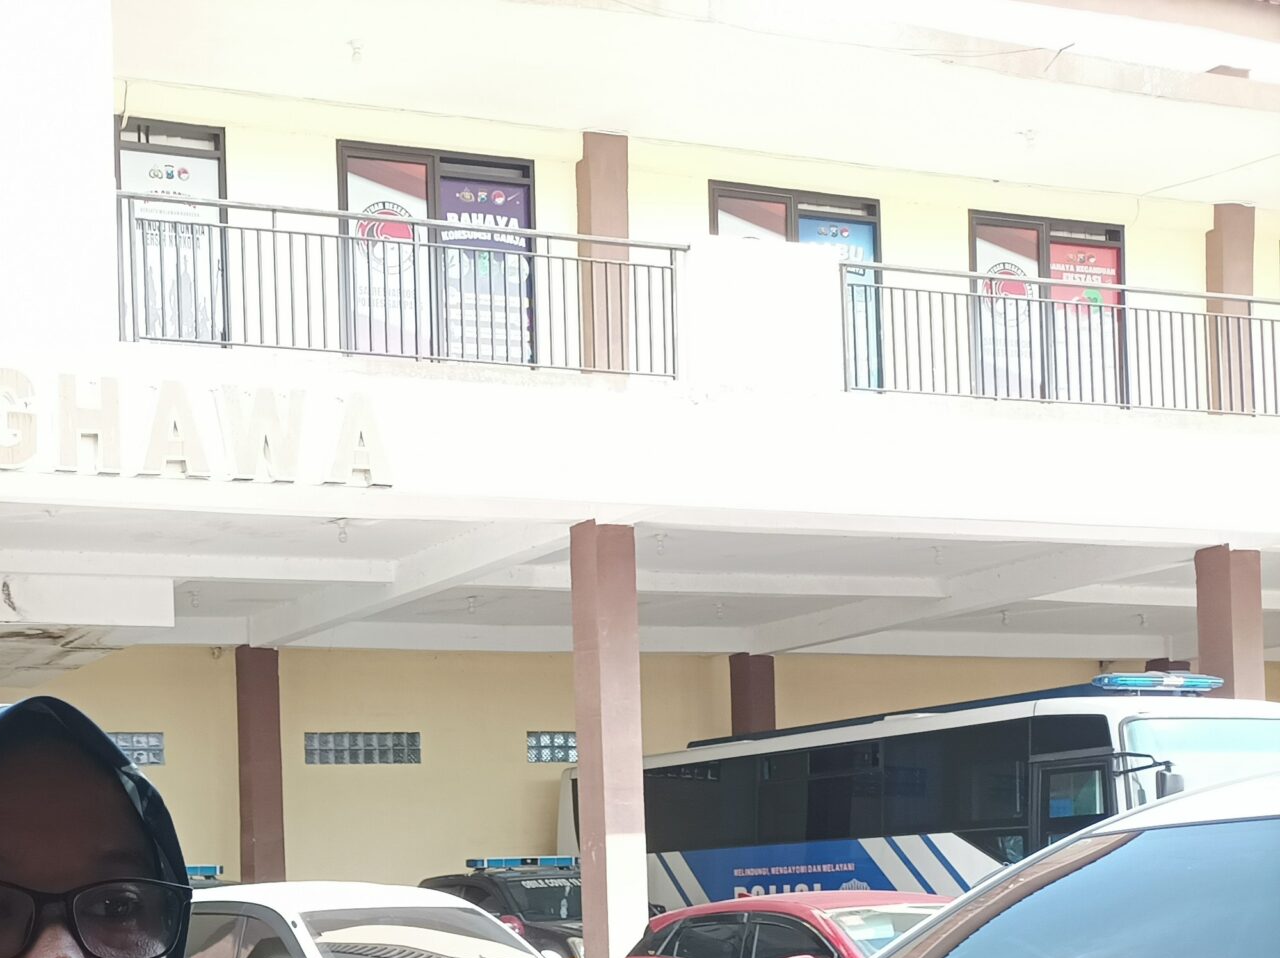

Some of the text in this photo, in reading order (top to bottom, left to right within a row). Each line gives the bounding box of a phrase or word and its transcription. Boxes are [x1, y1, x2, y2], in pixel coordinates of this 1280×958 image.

[441, 230, 527, 248] KONSUMSI GANJA
[807, 864, 822, 874] DAN
[822, 862, 855, 873] MELAYANI
